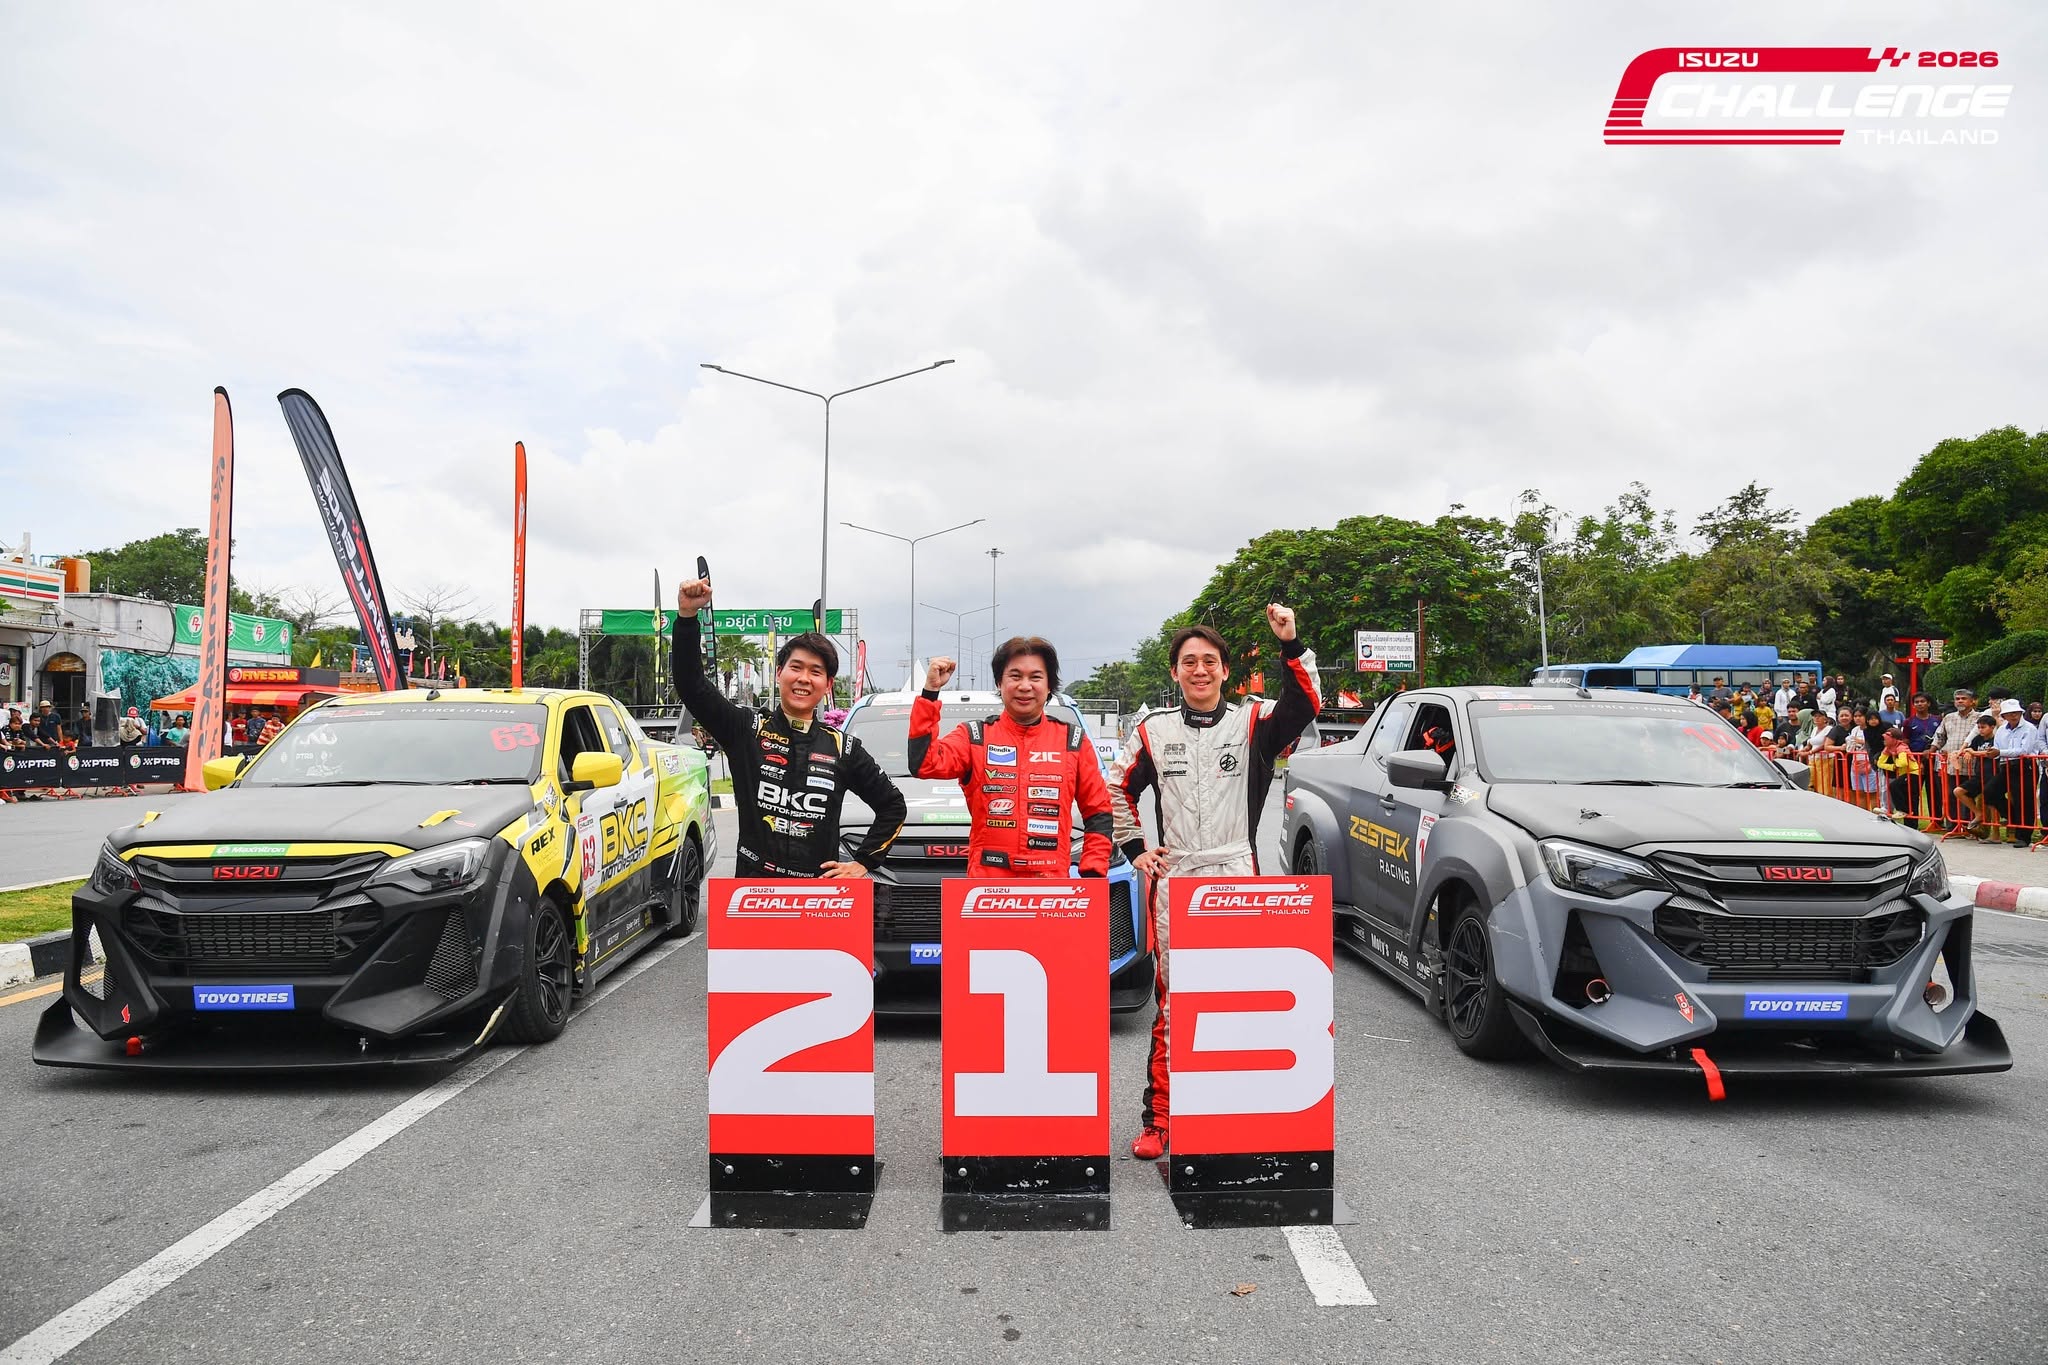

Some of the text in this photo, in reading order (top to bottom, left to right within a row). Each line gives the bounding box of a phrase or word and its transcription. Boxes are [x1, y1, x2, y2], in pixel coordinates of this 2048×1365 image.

[242, 671, 298, 680] FIVE STAR
[490, 722, 540, 752] 63
[154, 758, 180, 766] PTRS
[1029, 751, 1062, 762] ZIC
[28, 758, 56, 768] PTRS
[92, 758, 120, 768] PTRS
[761, 770, 783, 780] WHEELS
[758, 781, 828, 814] BKC
[758, 802, 826, 820] MOTORSPORT
[600, 798, 648, 867] BKC
[1350, 815, 1410, 862] ZESTEK
[531, 827, 556, 856] REX
[231, 845, 286, 854] Maxnitron
[927, 846, 969, 856] ISUZ
[582, 834, 596, 880] 63
[600, 845, 647, 883] MOTORSPORT
[212, 866, 280, 879] ISUZU
[1379, 858, 1410, 885] RACING
[1764, 868, 1832, 880] ISUZU
[742, 898, 854, 909] CHALLENGE
[978, 898, 1090, 910] CHALLENGE
[1204, 894, 1314, 906] CHALLENGE
[914, 948, 942, 958] TOY
[198, 992, 288, 1004] TOYO TIRES
[1750, 1000, 1842, 1012] TOYO TIRES
[708, 949, 874, 1116] 2
[954, 950, 1098, 1116] 1
[1169, 946, 1334, 1116] 3
